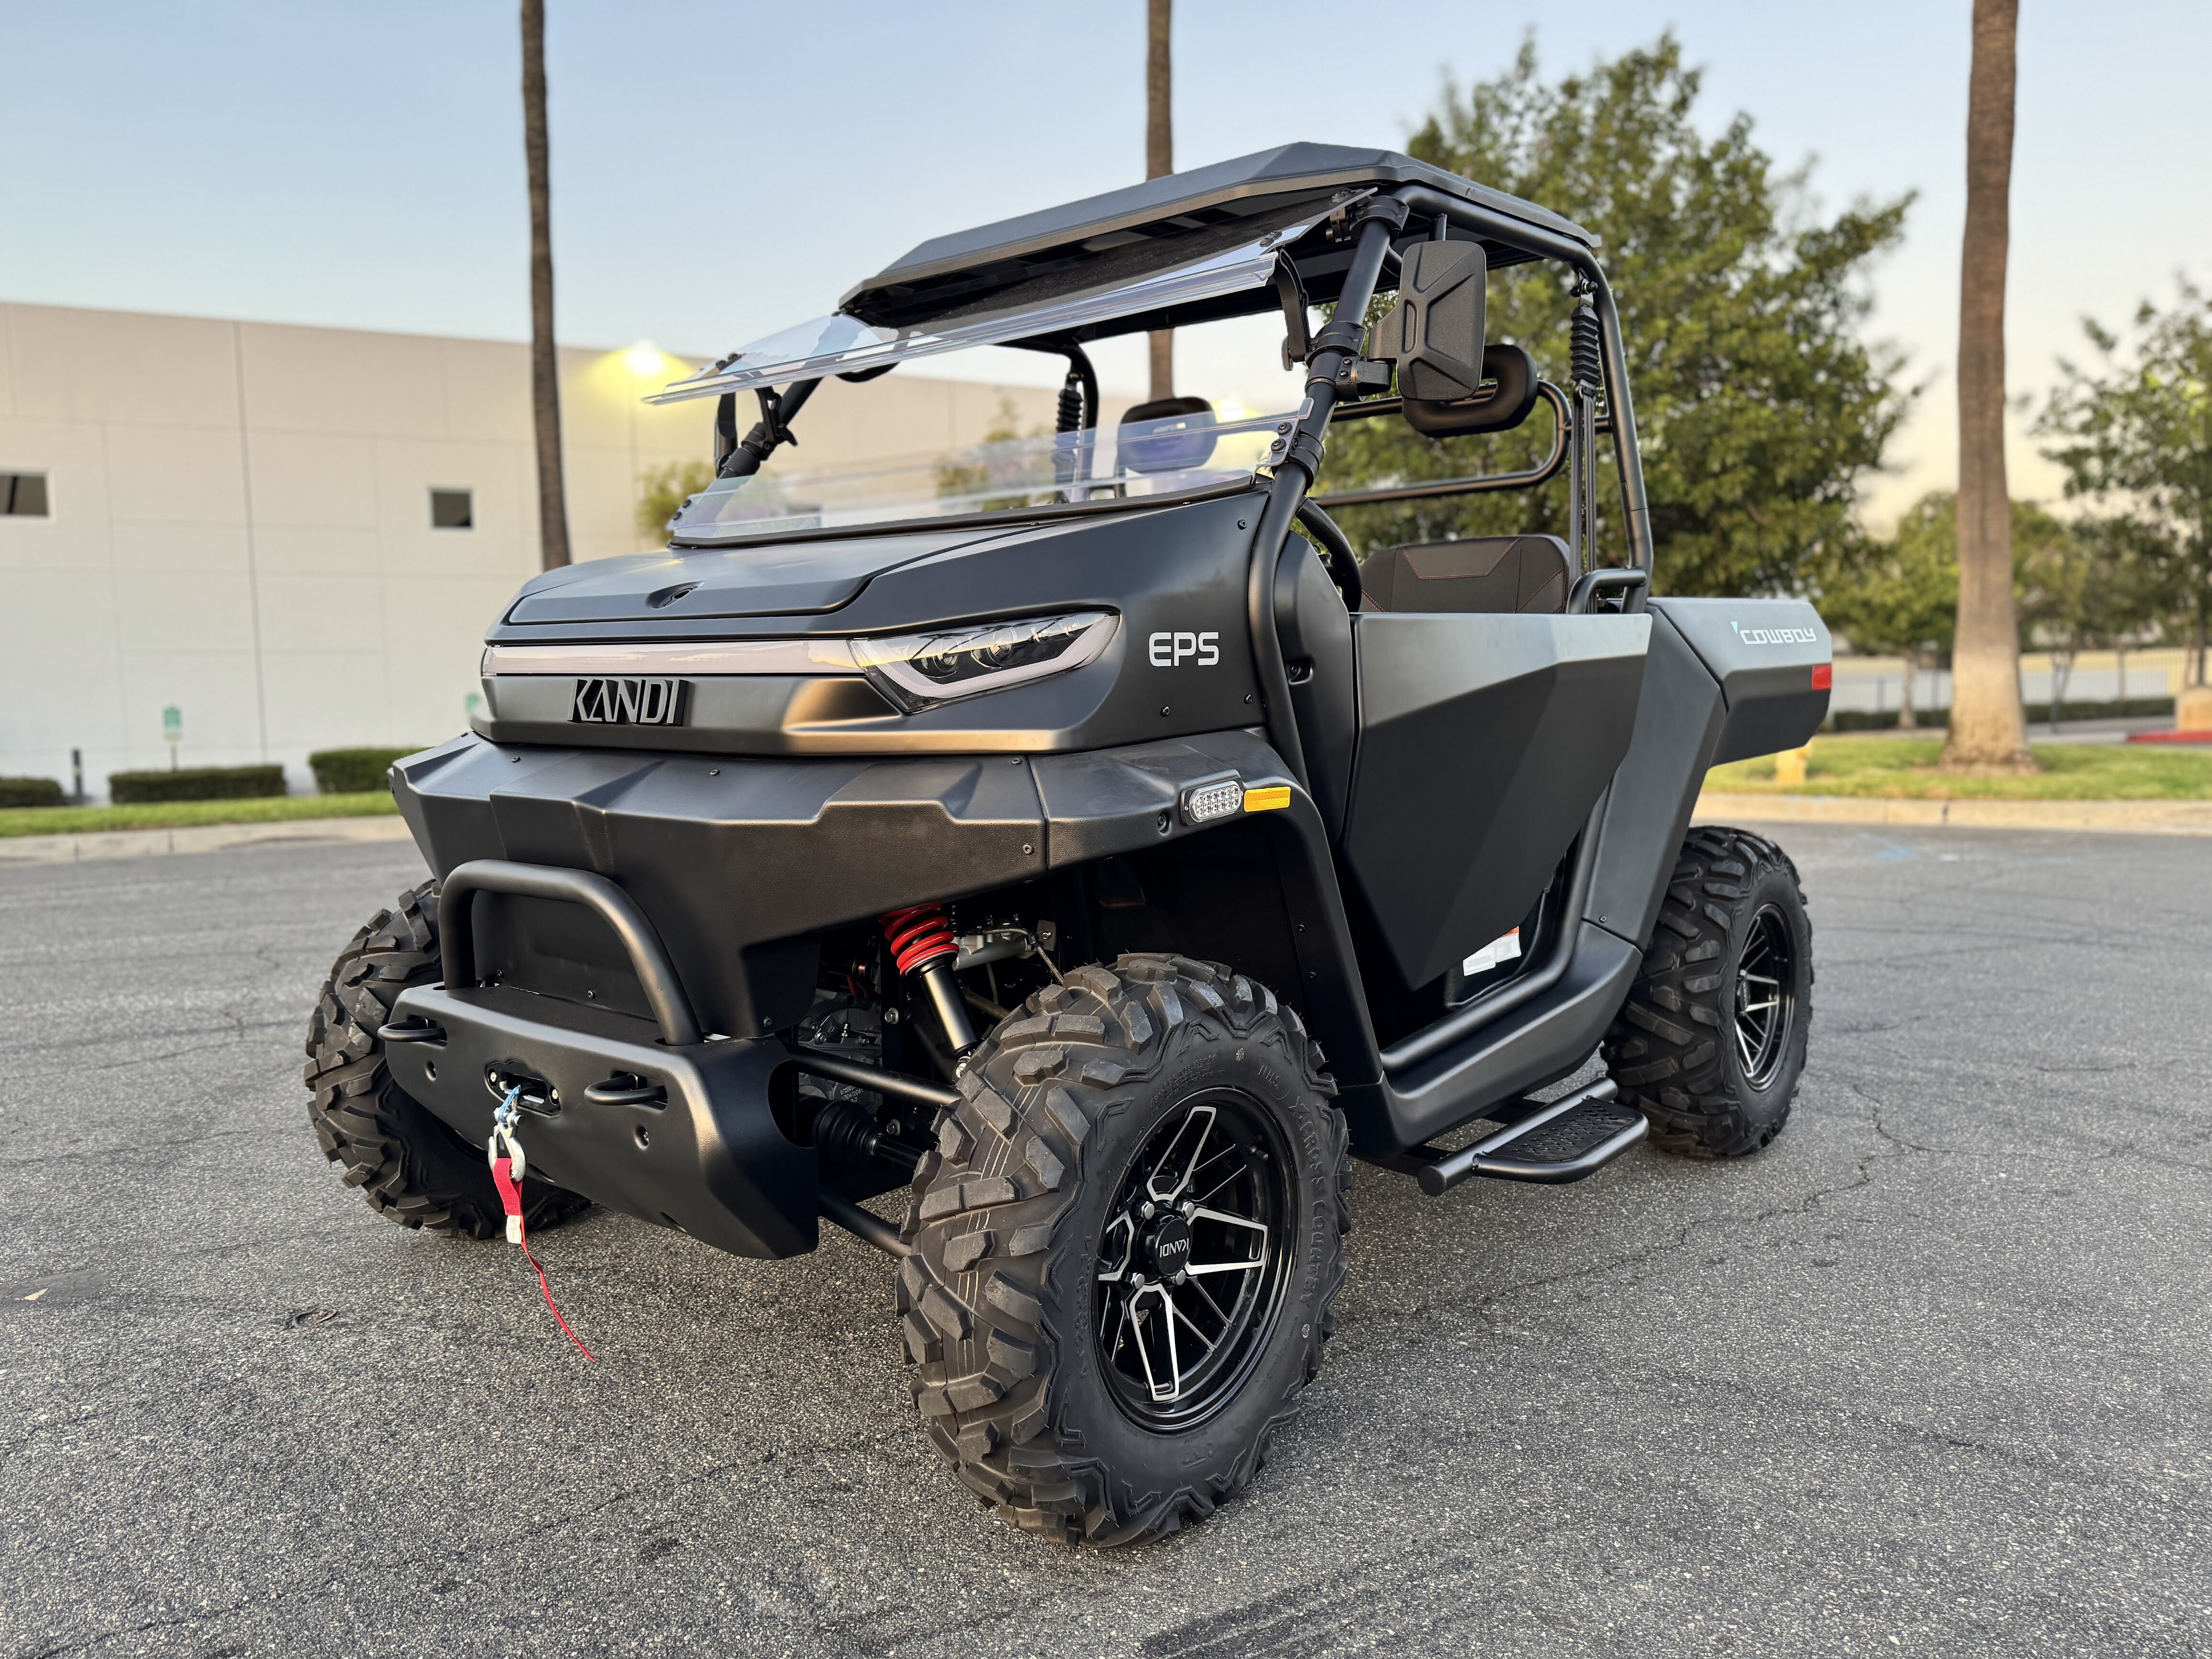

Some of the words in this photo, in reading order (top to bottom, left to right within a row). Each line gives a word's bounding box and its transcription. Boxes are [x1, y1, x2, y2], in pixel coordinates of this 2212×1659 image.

[1149, 632, 1219, 667] EPS
[1740, 628, 1817, 645] COWBOY
[568, 679, 682, 724] KANDI
[1159, 1238, 1189, 1258] KANDI
